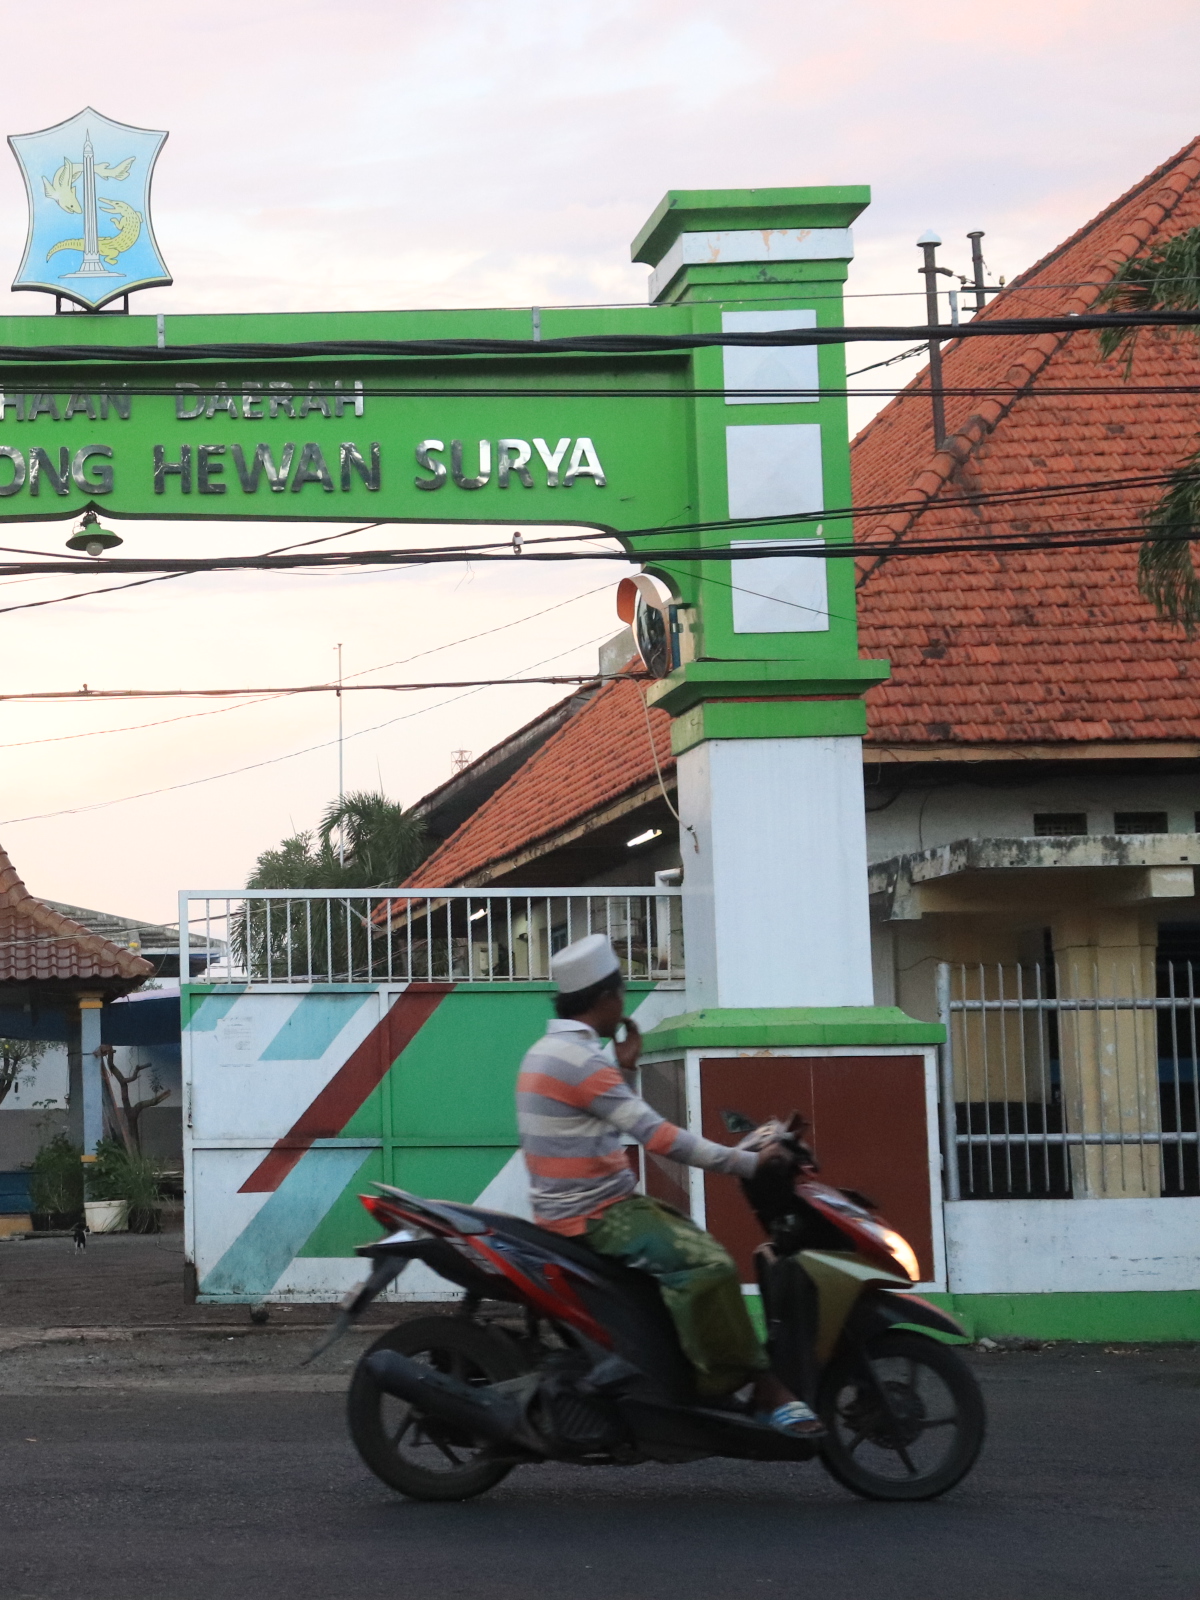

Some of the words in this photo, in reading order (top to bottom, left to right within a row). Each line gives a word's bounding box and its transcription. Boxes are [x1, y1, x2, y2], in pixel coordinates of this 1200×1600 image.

[175, 380, 364, 419] DAERAH
[153, 442, 381, 494] HEWAN
[415, 437, 607, 490] SURYA
